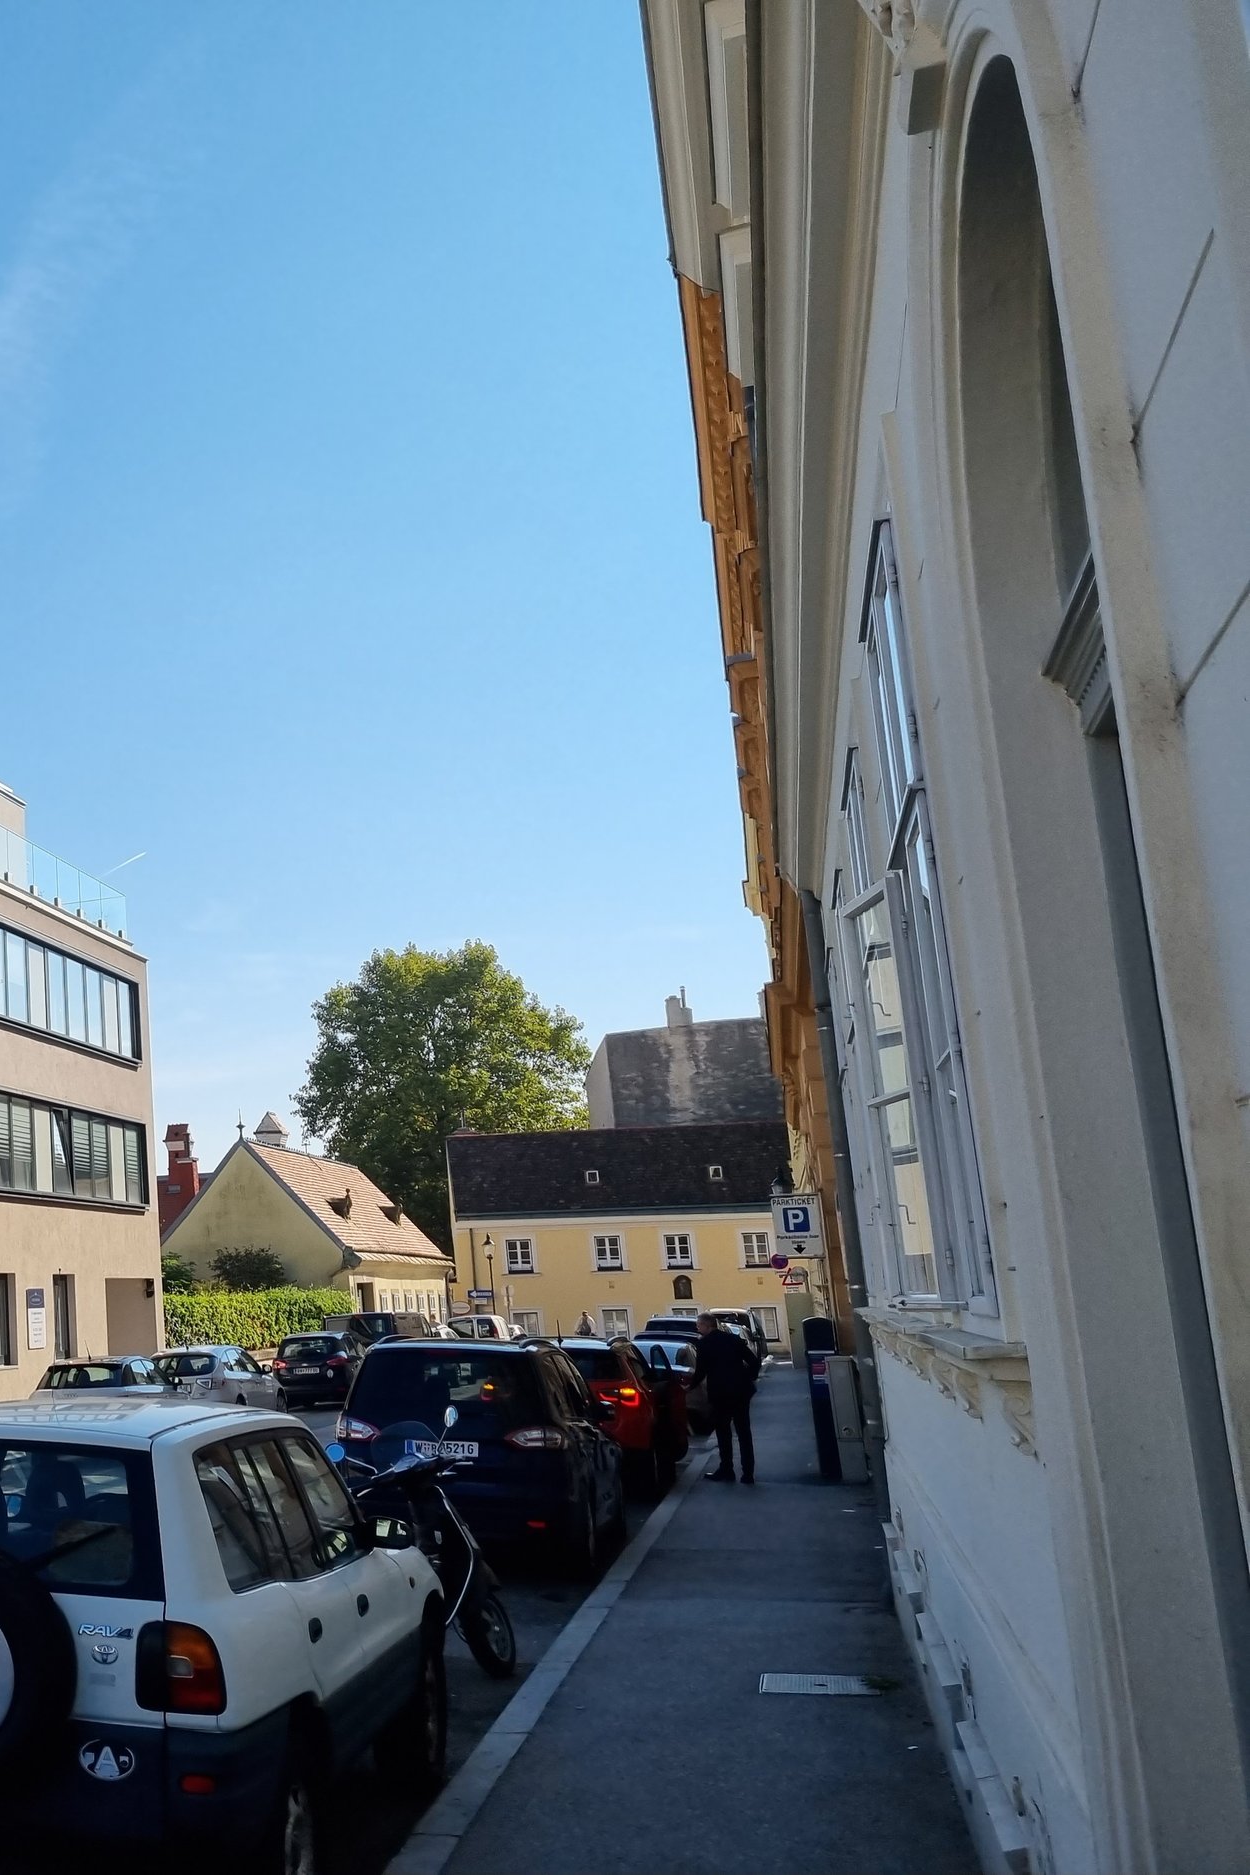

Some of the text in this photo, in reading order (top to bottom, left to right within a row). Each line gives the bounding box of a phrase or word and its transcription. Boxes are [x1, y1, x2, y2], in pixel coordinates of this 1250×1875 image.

[772, 1198, 815, 1206] PARKTICKET
[787, 1209, 804, 1231] P
[415, 1442, 423, 1452] W
[78, 1624, 134, 1640] RAV4
